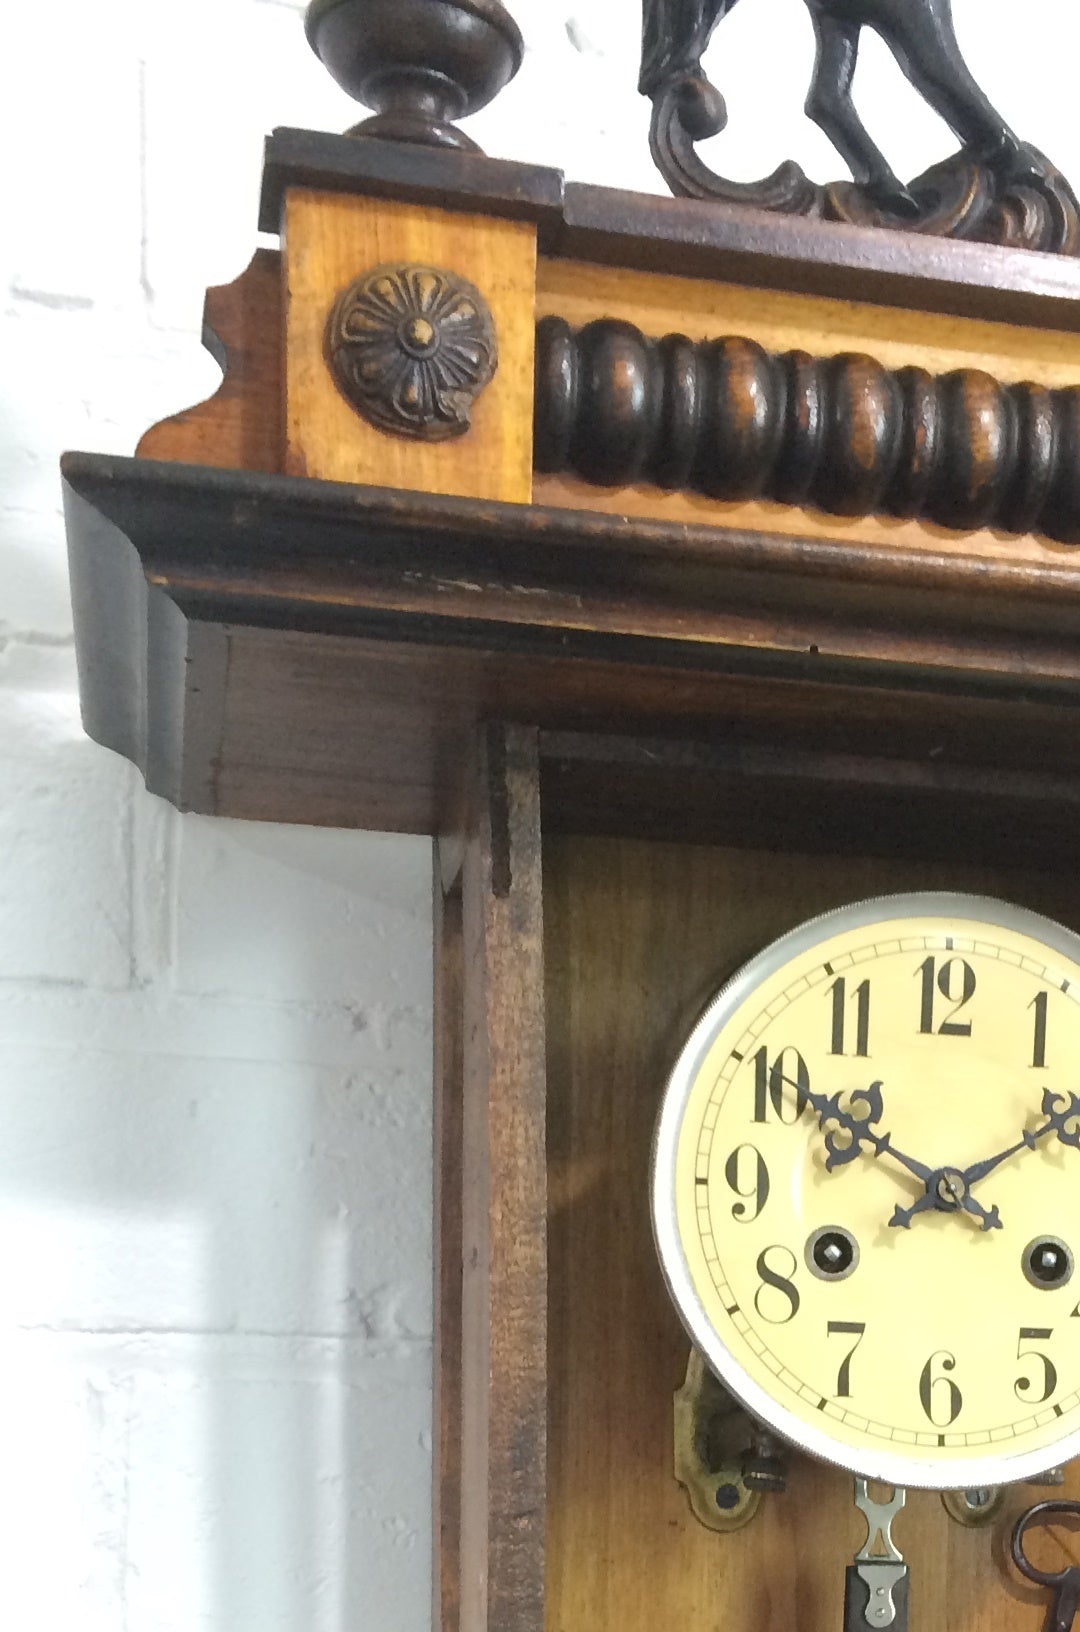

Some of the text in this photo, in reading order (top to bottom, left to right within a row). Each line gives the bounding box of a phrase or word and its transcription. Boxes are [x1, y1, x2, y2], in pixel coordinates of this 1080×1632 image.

[826, 977, 870, 1058] 11
[914, 956, 976, 1037] 12
[1028, 991, 1049, 1068] 1
[748, 1045, 810, 1125] 10
[725, 1144, 770, 1222] 9
[754, 1244, 800, 1324] 8
[827, 1321, 866, 1398] 7
[919, 1350, 962, 1426] 6
[1013, 1328, 1057, 1404] 5
